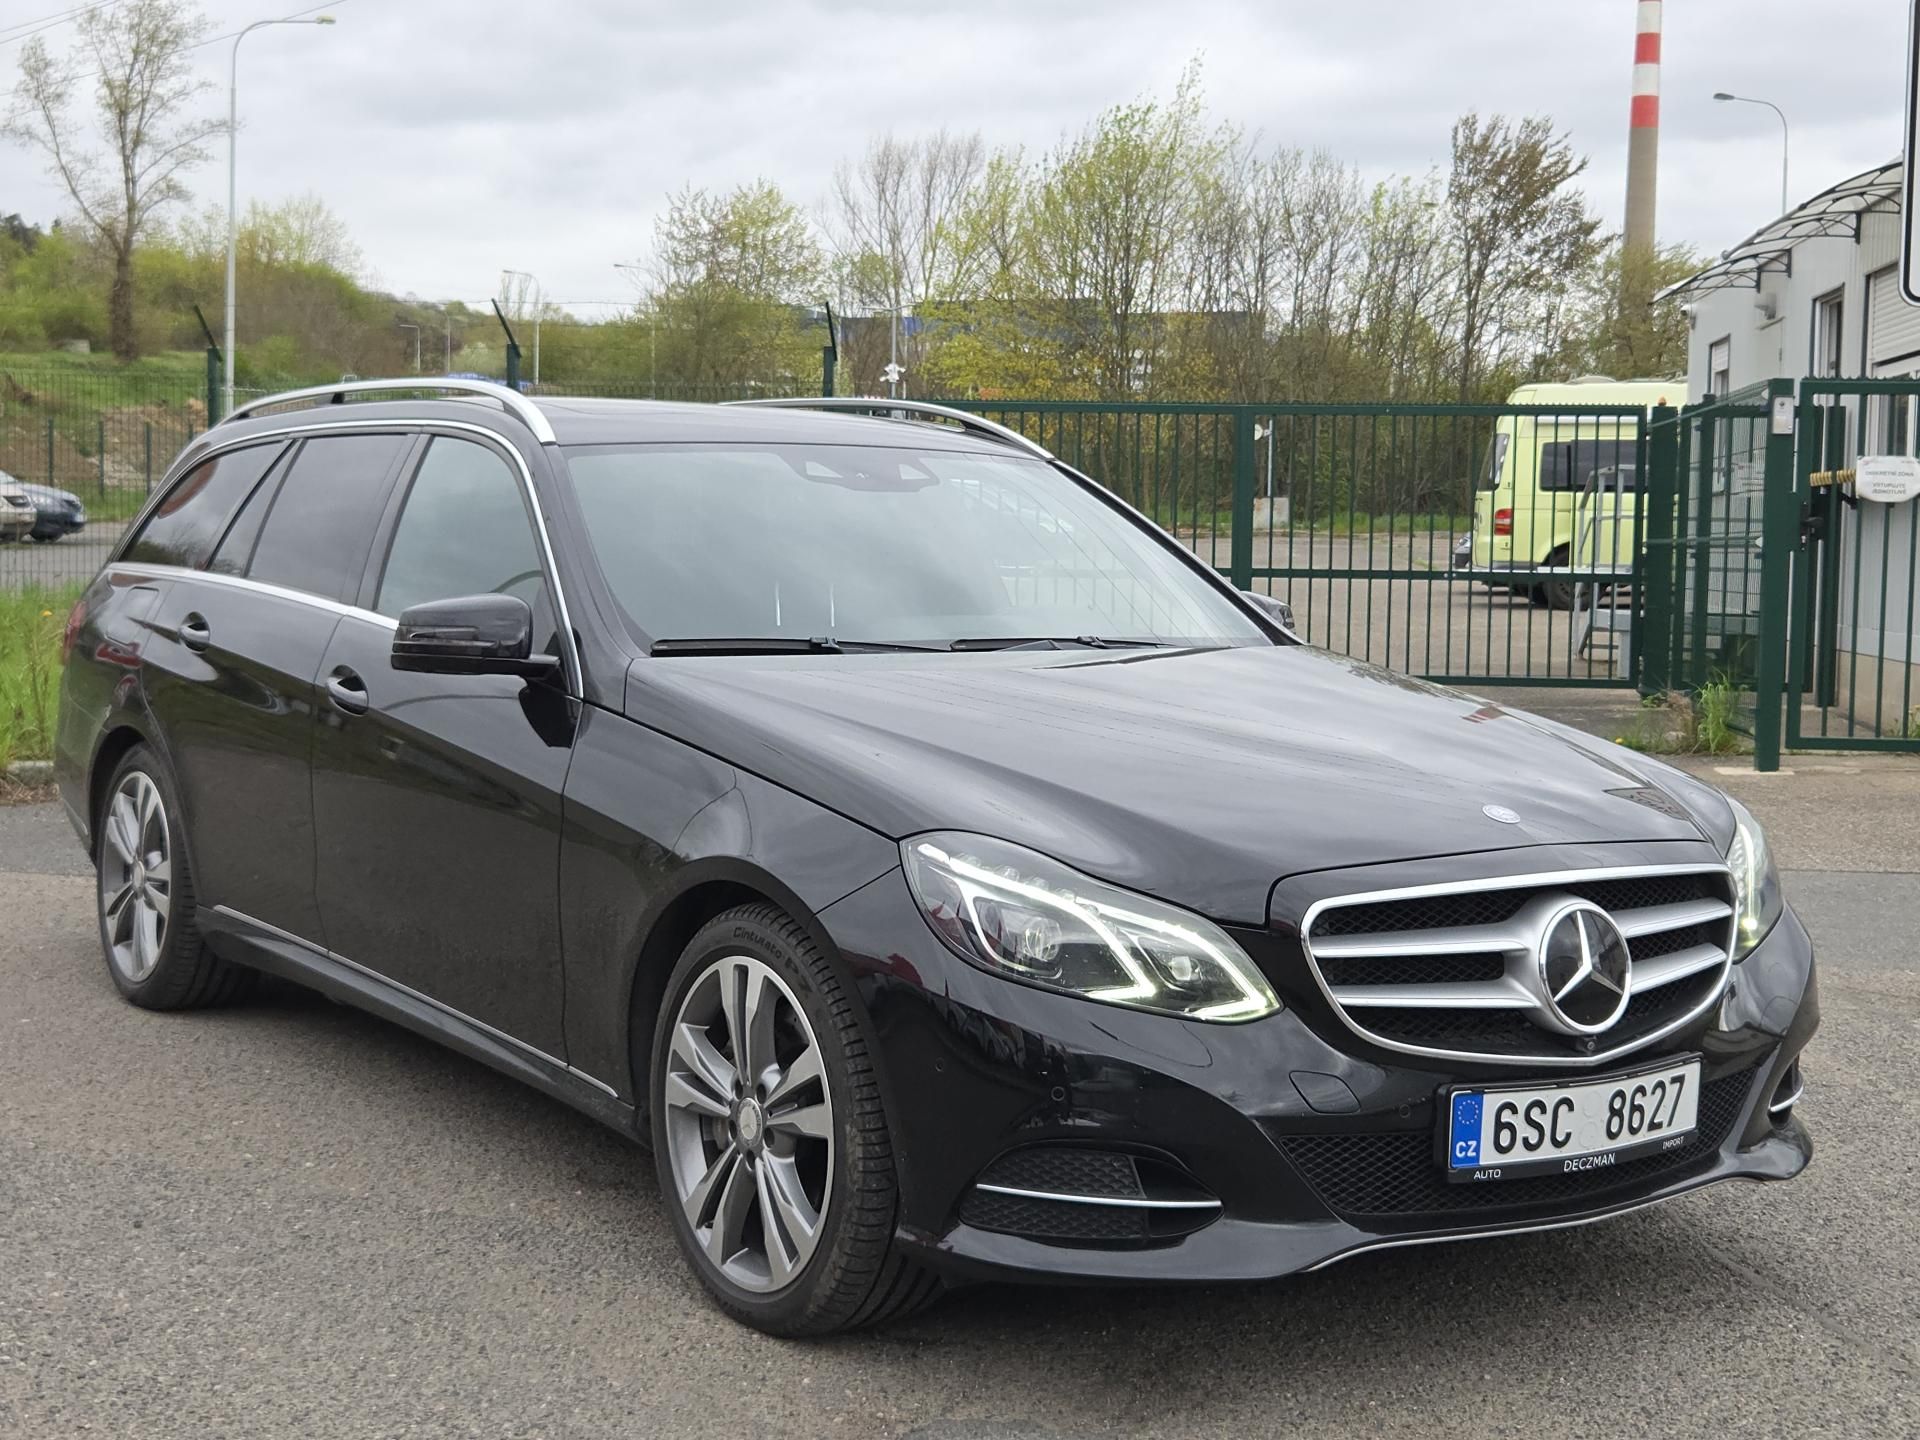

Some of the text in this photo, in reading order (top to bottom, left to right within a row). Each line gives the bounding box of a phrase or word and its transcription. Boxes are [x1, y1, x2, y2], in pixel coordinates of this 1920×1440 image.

[733, 926, 783, 959] Cinturato
[1455, 1073, 1687, 1158] CZ 6SC 8627
[1473, 1136, 1685, 1180] AUTO DECZMAN IMPORT
